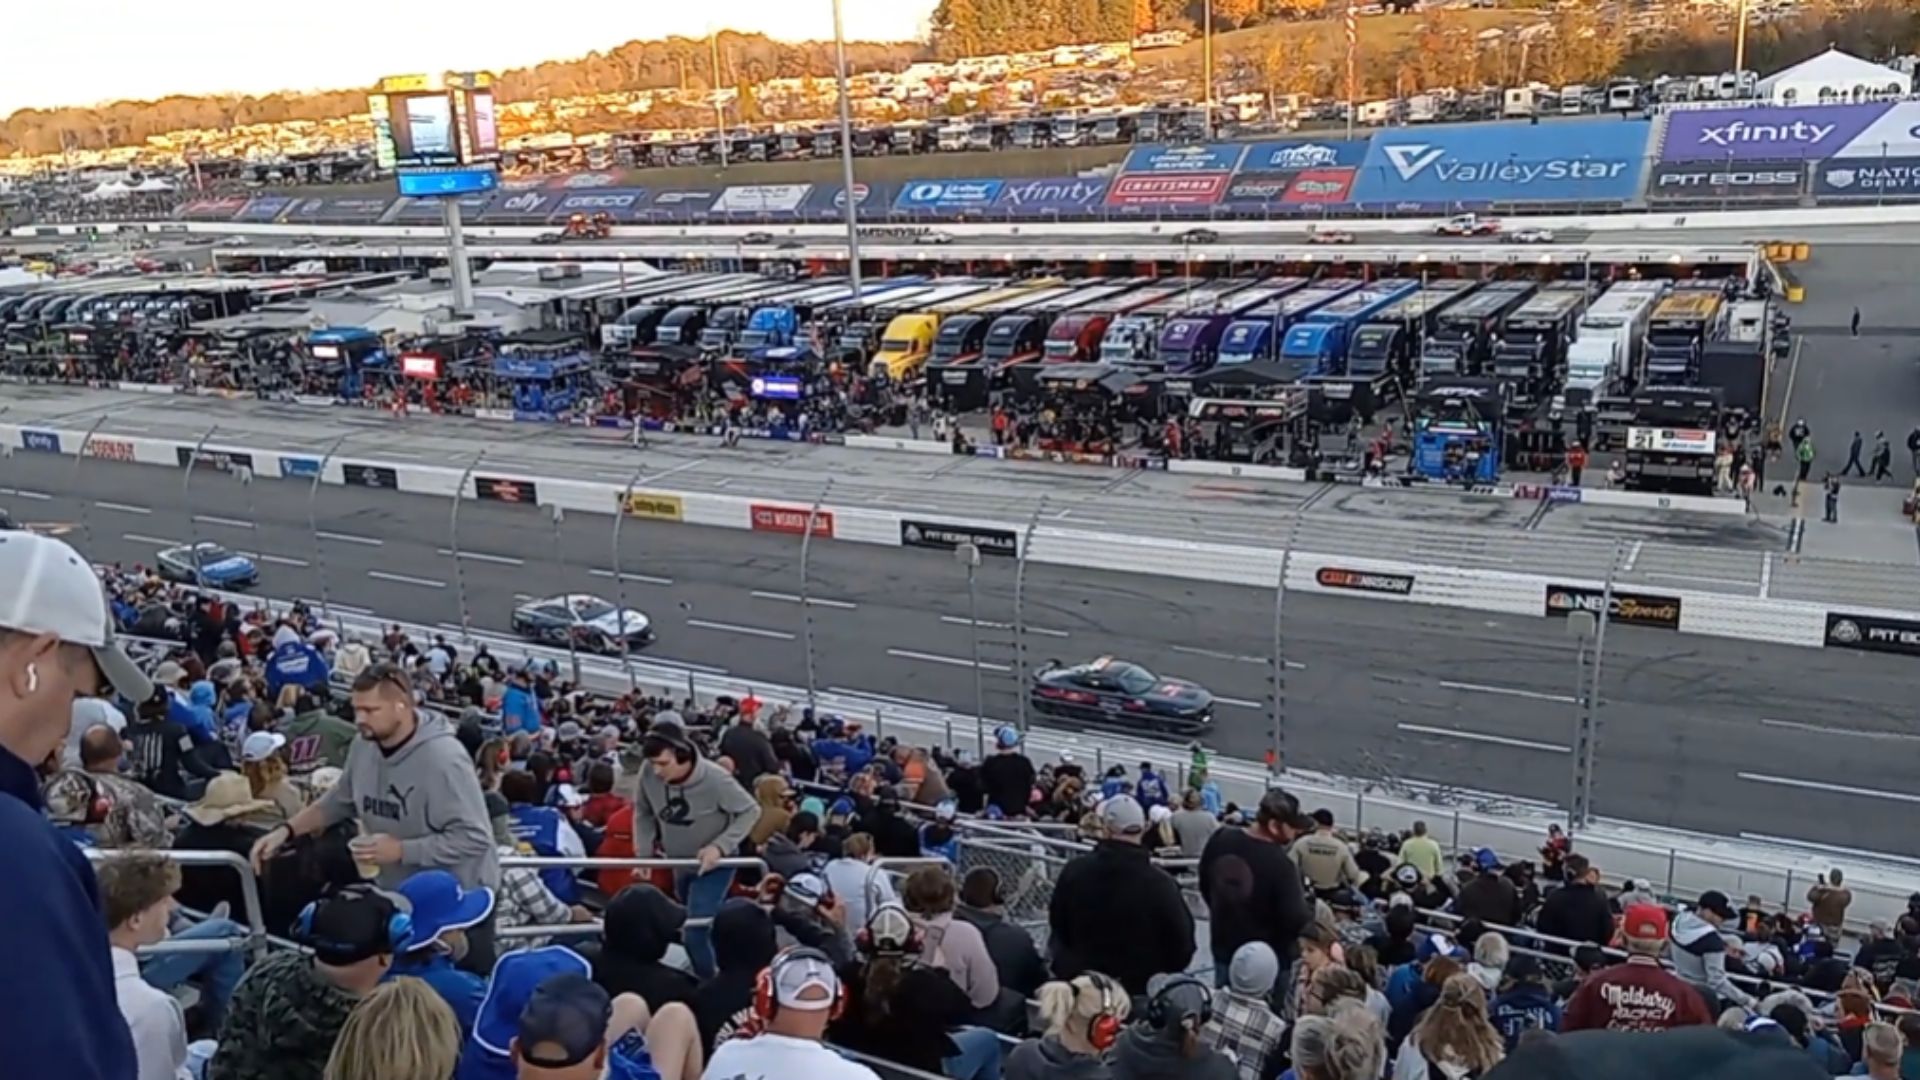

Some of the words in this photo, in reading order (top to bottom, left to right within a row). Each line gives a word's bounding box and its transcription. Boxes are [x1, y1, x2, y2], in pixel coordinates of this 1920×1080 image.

[1699, 120, 1836, 145] xfinity
[1434, 159, 1627, 183] ValleyStar
[1659, 173, 1708, 187] PIT
[1709, 171, 1801, 185] BOSS
[1002, 181, 1104, 205] xfinity
[1125, 180, 1212, 191] CRAFTSMAN
[504, 192, 547, 212] ally
[565, 195, 635, 208] GEICO
[1634, 435, 1653, 449] 21
[1575, 593, 1620, 613] NBC
[1620, 598, 1677, 619] Sports
[1869, 627, 1900, 642] PIT
[363, 795, 400, 821] PUMA
